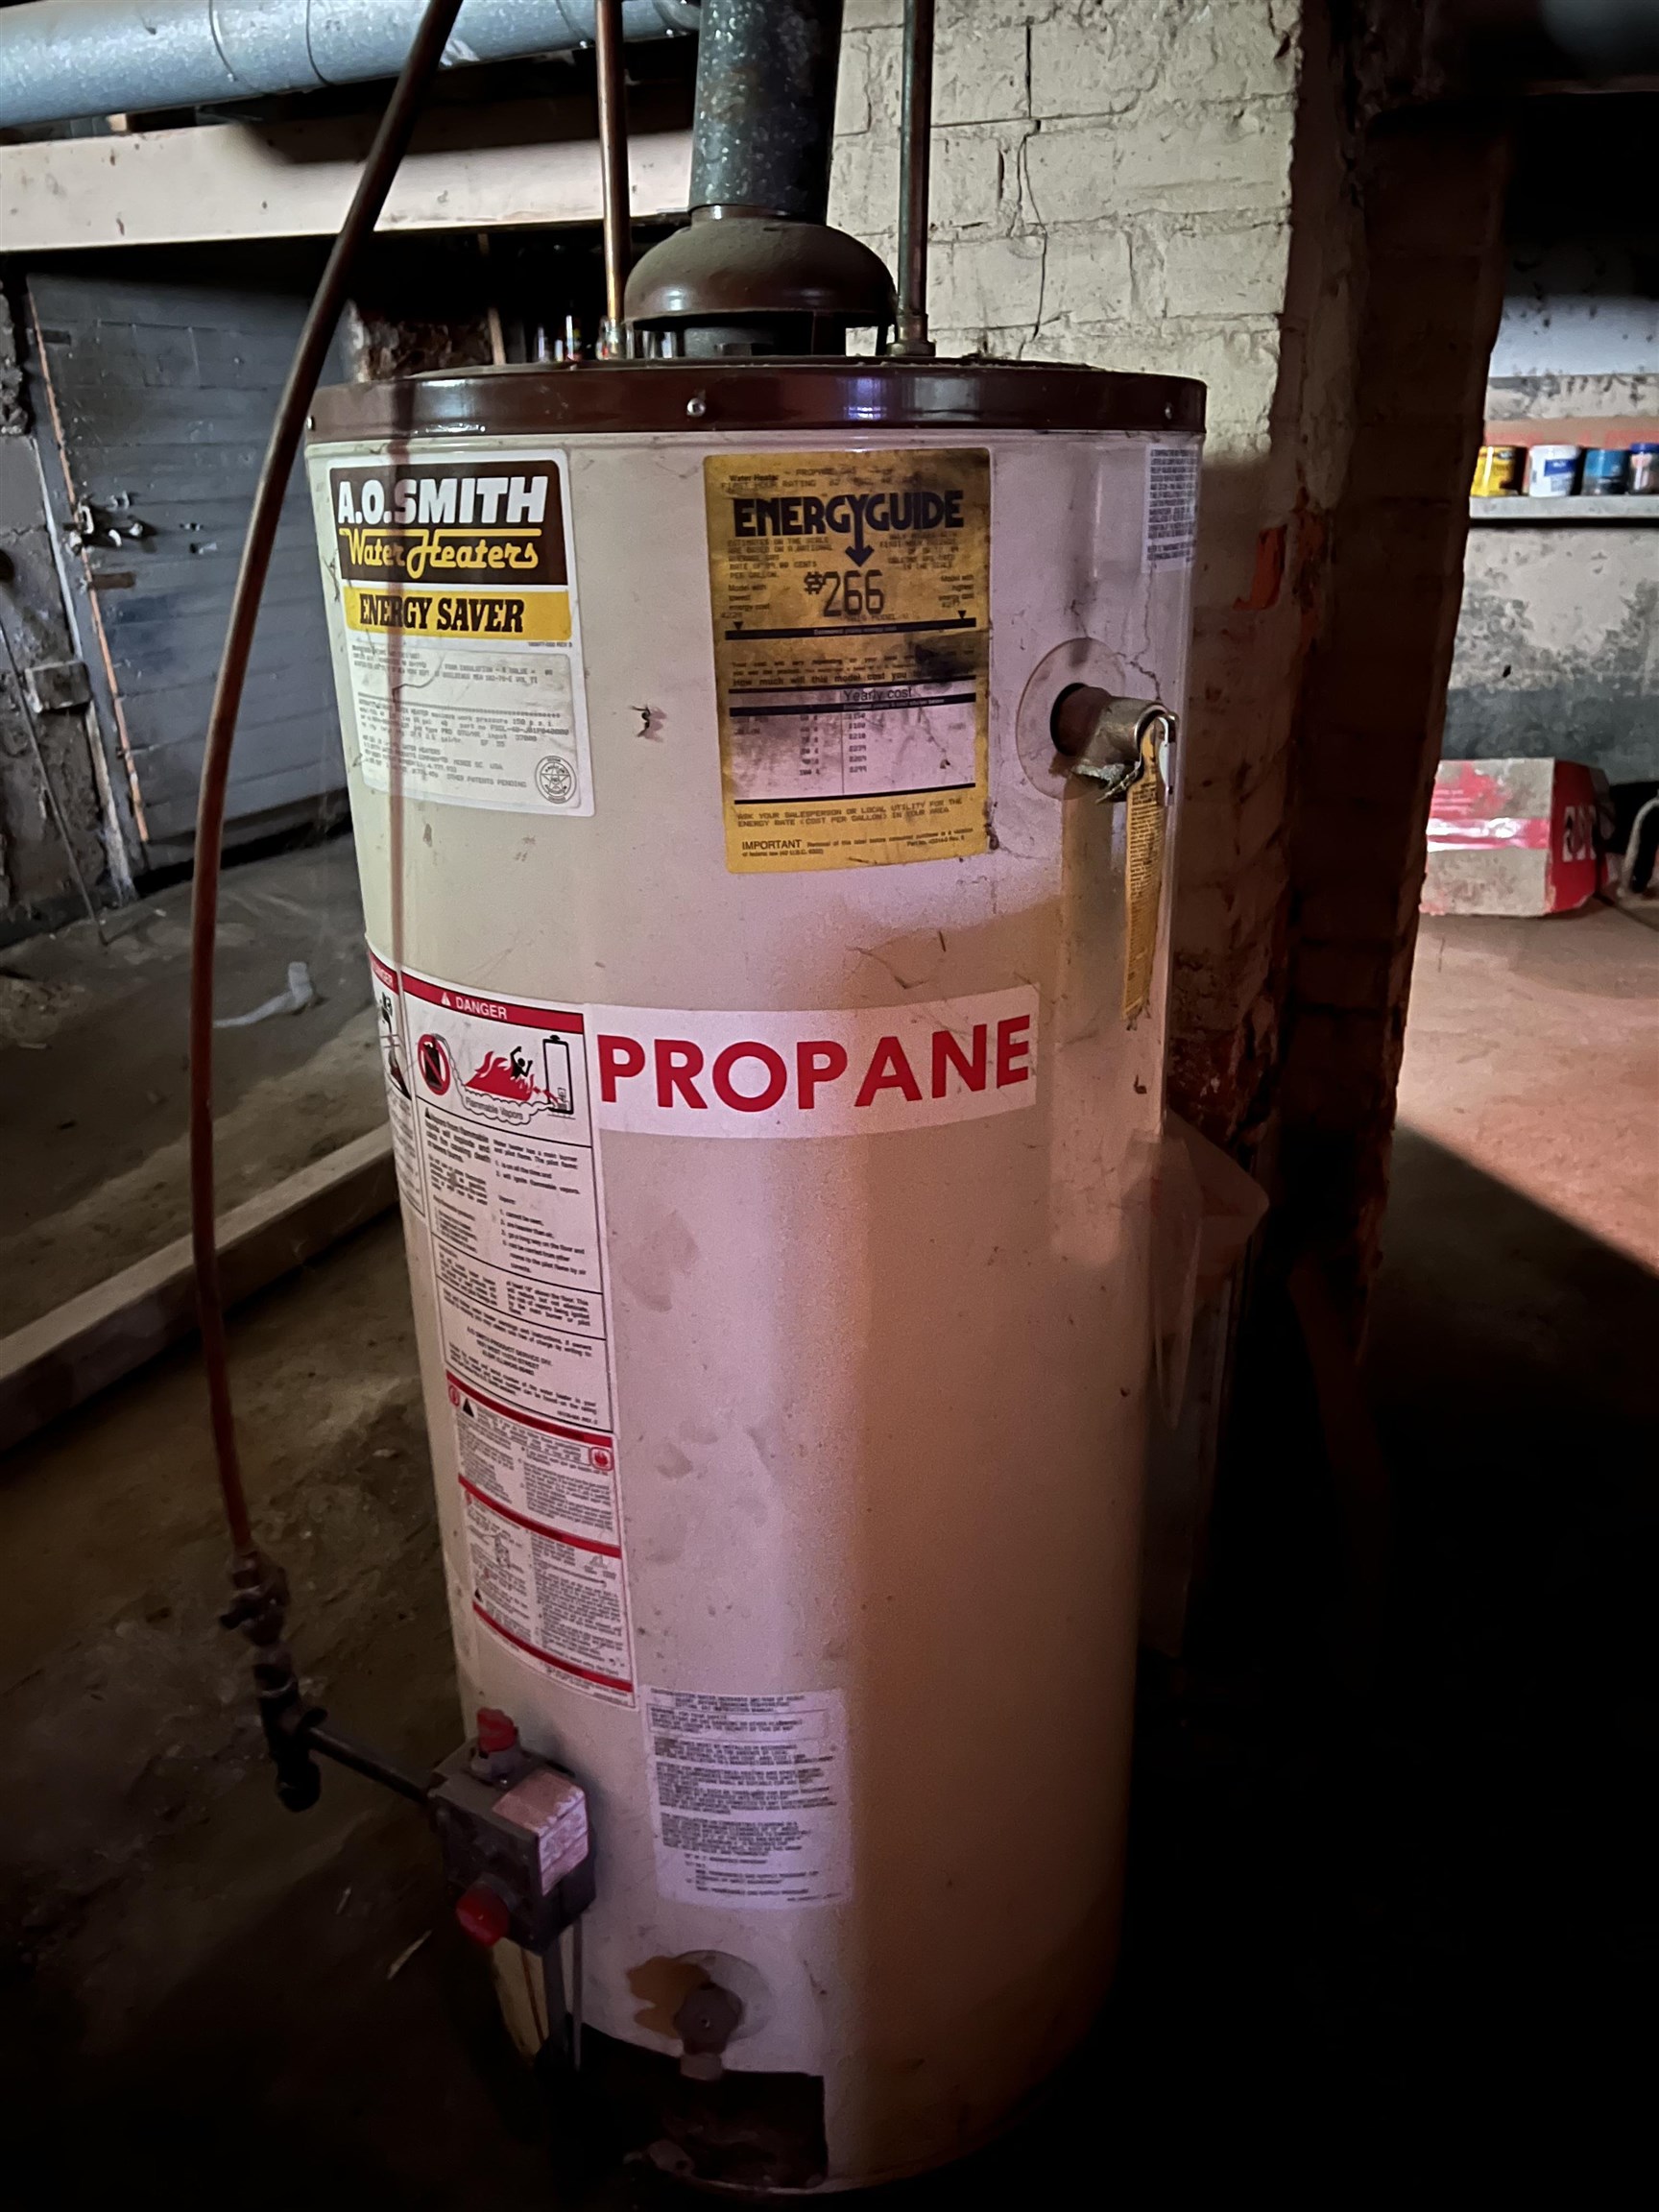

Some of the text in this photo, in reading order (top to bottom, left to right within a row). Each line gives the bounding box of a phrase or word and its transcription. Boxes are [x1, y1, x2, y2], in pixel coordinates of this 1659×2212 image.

[733, 491, 964, 538] ENERGYGUIDE
[339, 529, 541, 578] Water Heaters
[360, 593, 525, 633] ENERGY SAVER
[811, 675, 828, 684] this
[834, 673, 861, 683] model
[891, 672, 906, 681] you
[844, 686, 912, 702] Yearly cost
[784, 809, 841, 818] SALESPERSON
[891, 802, 926, 811] UTILITY
[741, 839, 803, 851] IMPORTANT
[456, 997, 508, 1020] DANGER
[597, 1015, 1030, 1113] PROPANE
